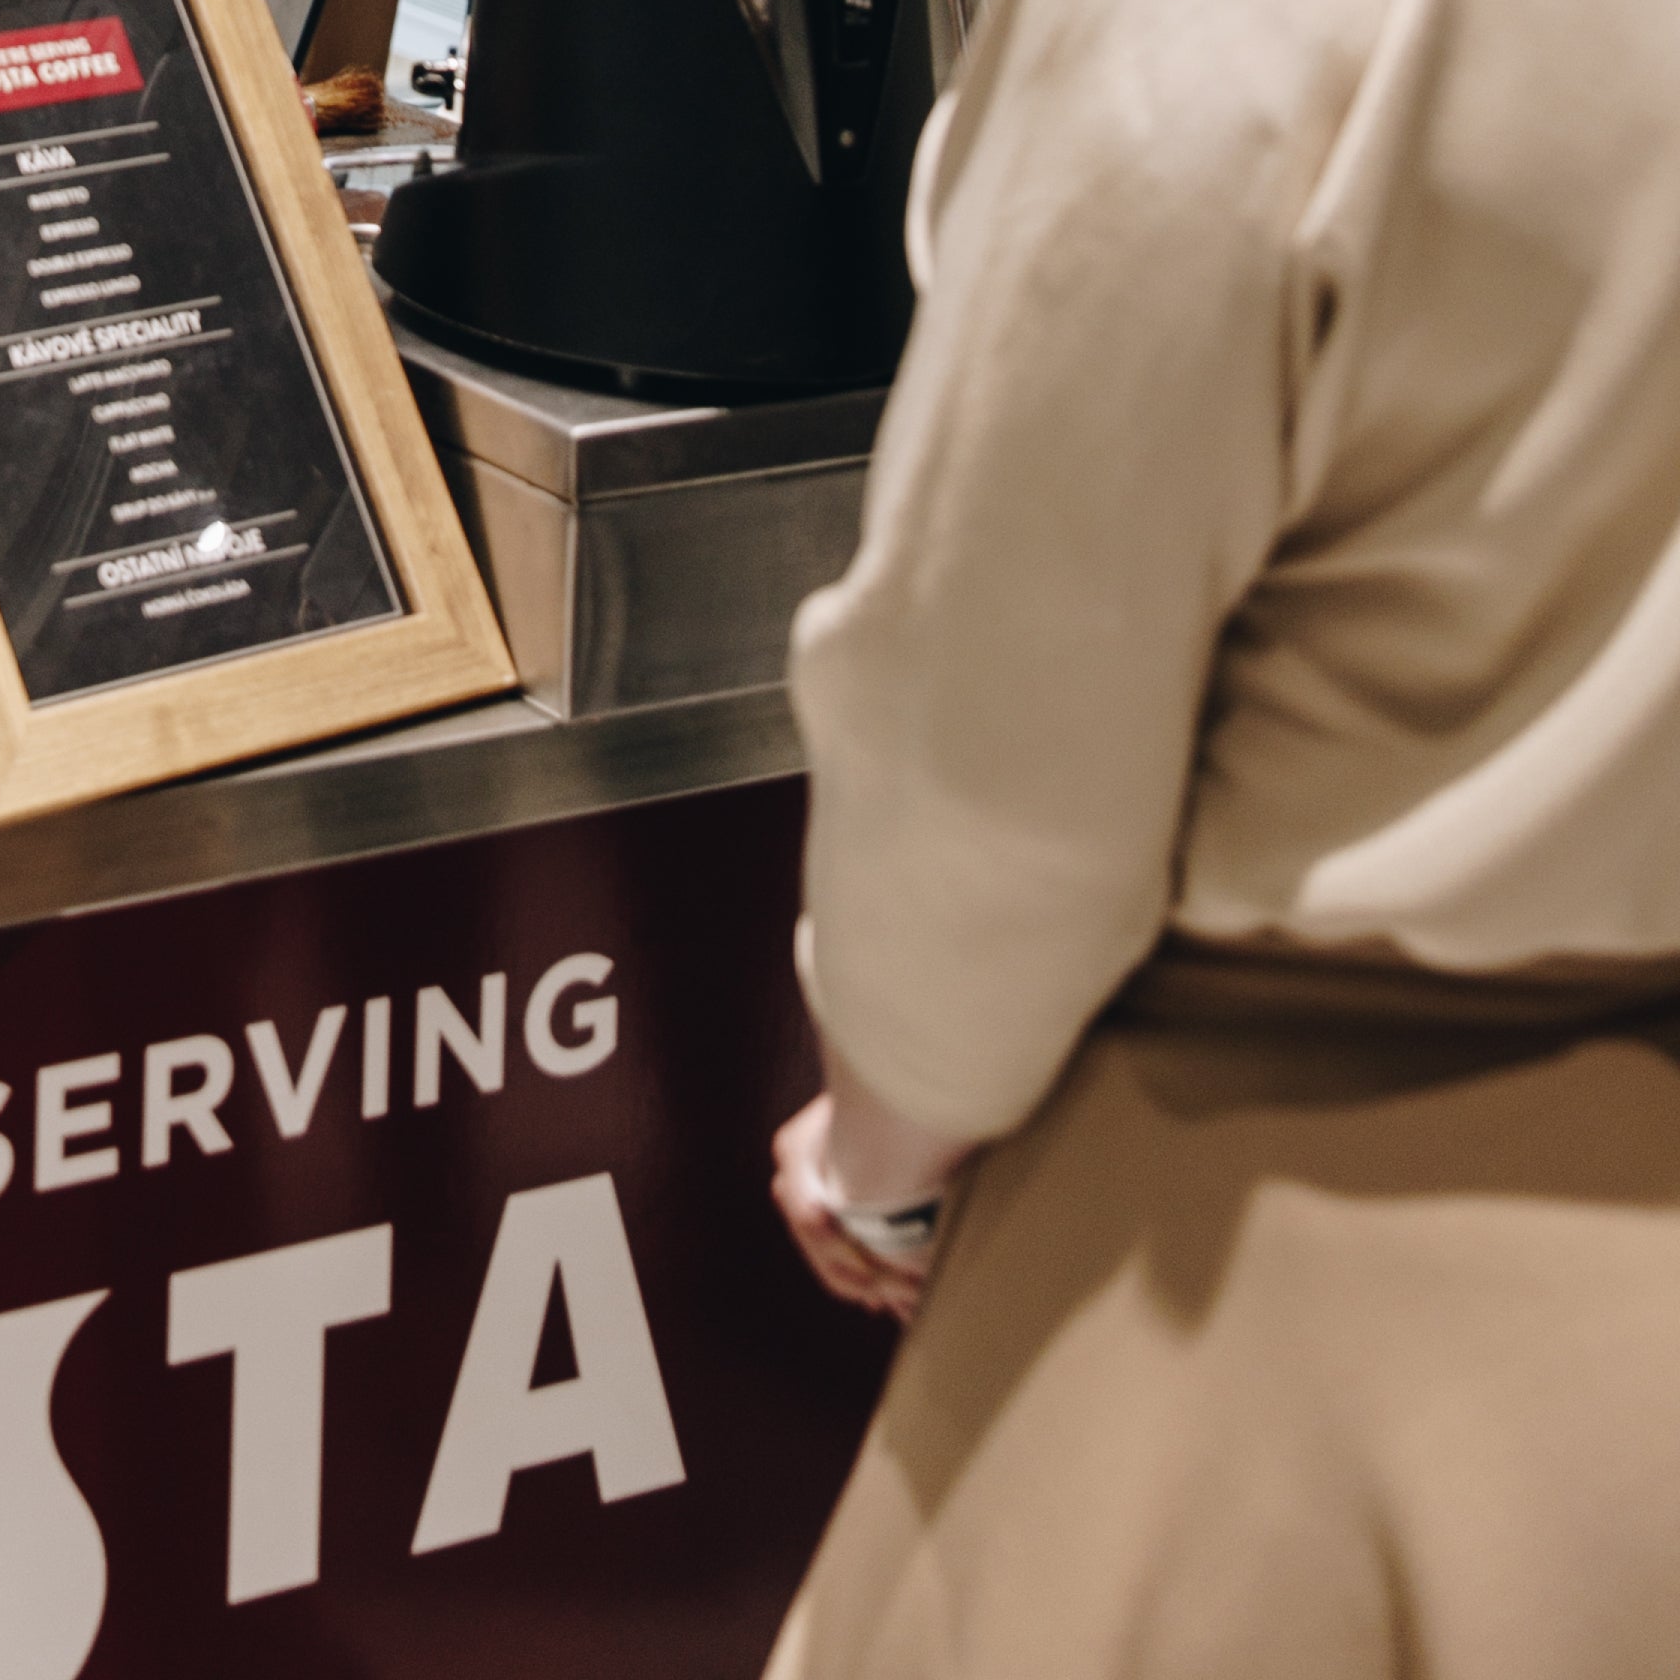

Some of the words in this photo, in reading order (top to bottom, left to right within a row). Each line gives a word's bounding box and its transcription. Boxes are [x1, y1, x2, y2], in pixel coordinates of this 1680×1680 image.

[37, 51, 121, 85] COFFEE
[16, 143, 76, 175] KÁVA
[8, 326, 94, 368] KÁVOVÉ
[94, 309, 201, 353] SPECIALITY
[97, 539, 188, 589] OSTATNÍ
